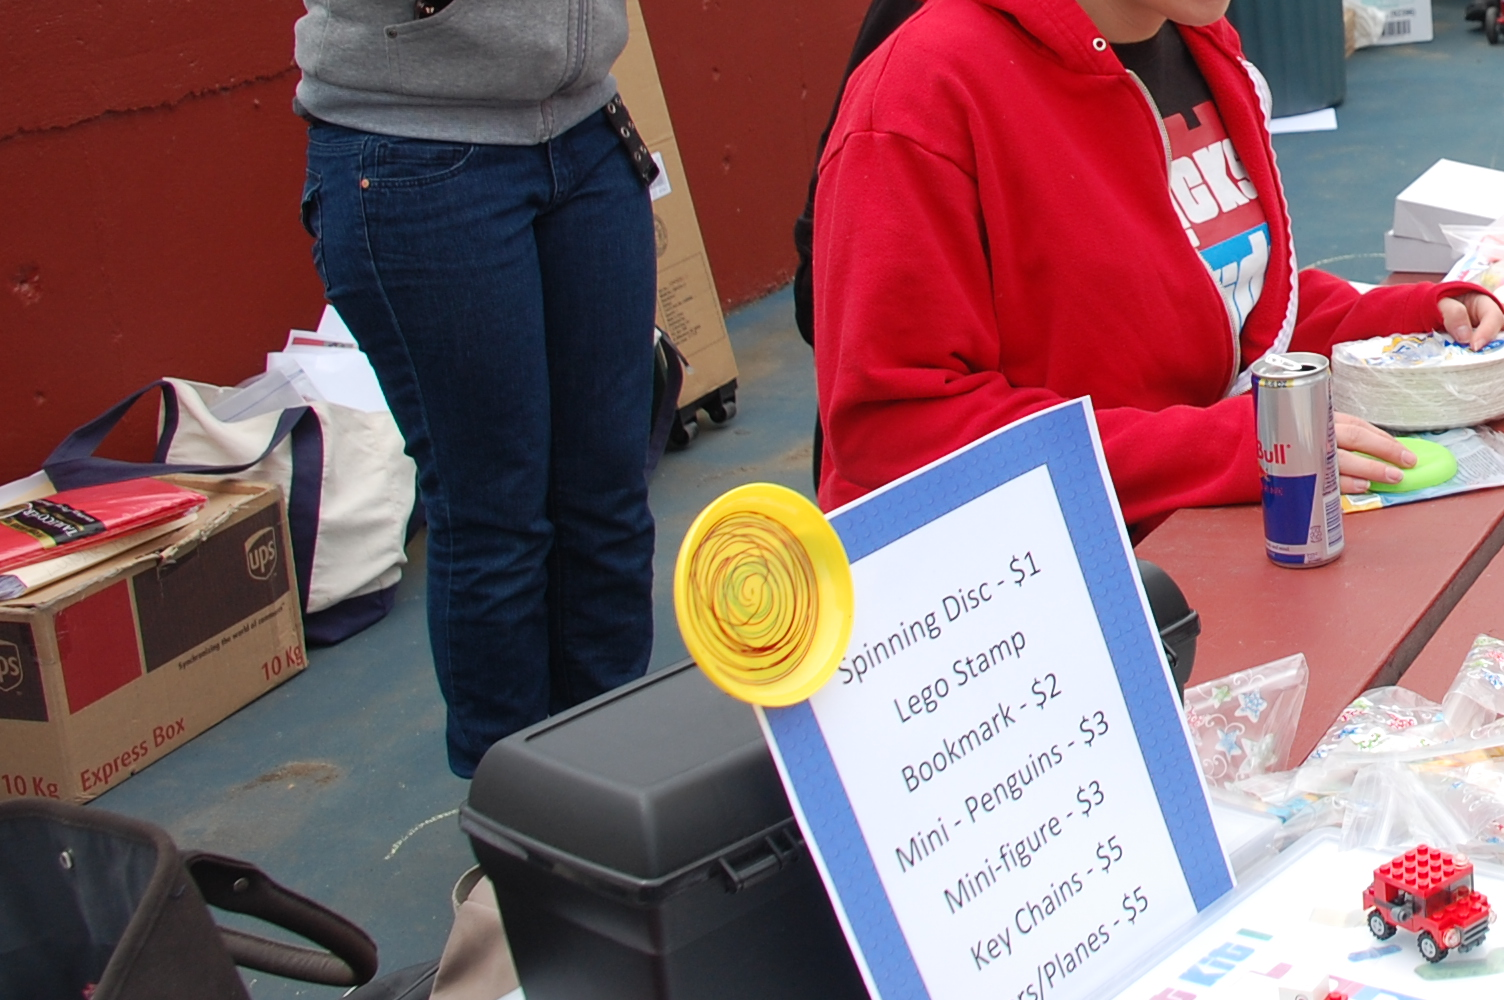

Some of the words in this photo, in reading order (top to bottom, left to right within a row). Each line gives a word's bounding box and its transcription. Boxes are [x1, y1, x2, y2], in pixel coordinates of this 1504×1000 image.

[249, 540, 275, 573] ups
[838, 611, 942, 686] Spinning
[942, 579, 993, 624] Disc
[1009, 550, 1042, 588] $1
[0, 656, 20, 684] ps
[262, 655, 283, 681] 10
[285, 645, 305, 669] Kg
[893, 676, 951, 724] Lego
[953, 628, 1027, 691] Stamp
[80, 737, 149, 793] Express
[152, 717, 186, 750] Box
[900, 698, 1016, 794] Bookmark
[1032, 671, 1063, 710] $2
[2, 774, 27, 797] 10
[32, 776, 60, 799] Kg
[894, 818, 951, 874] Mini
[965, 744, 1063, 828] Penguins
[1079, 709, 1111, 750] $3
[943, 812, 1063, 916] Mini-figure
[1076, 779, 1106, 819] $3
[970, 929, 1013, 971] Key
[1015, 871, 1084, 938] Chains
[1096, 834, 1125, 875] $5
[1121, 885, 1150, 927] $5
